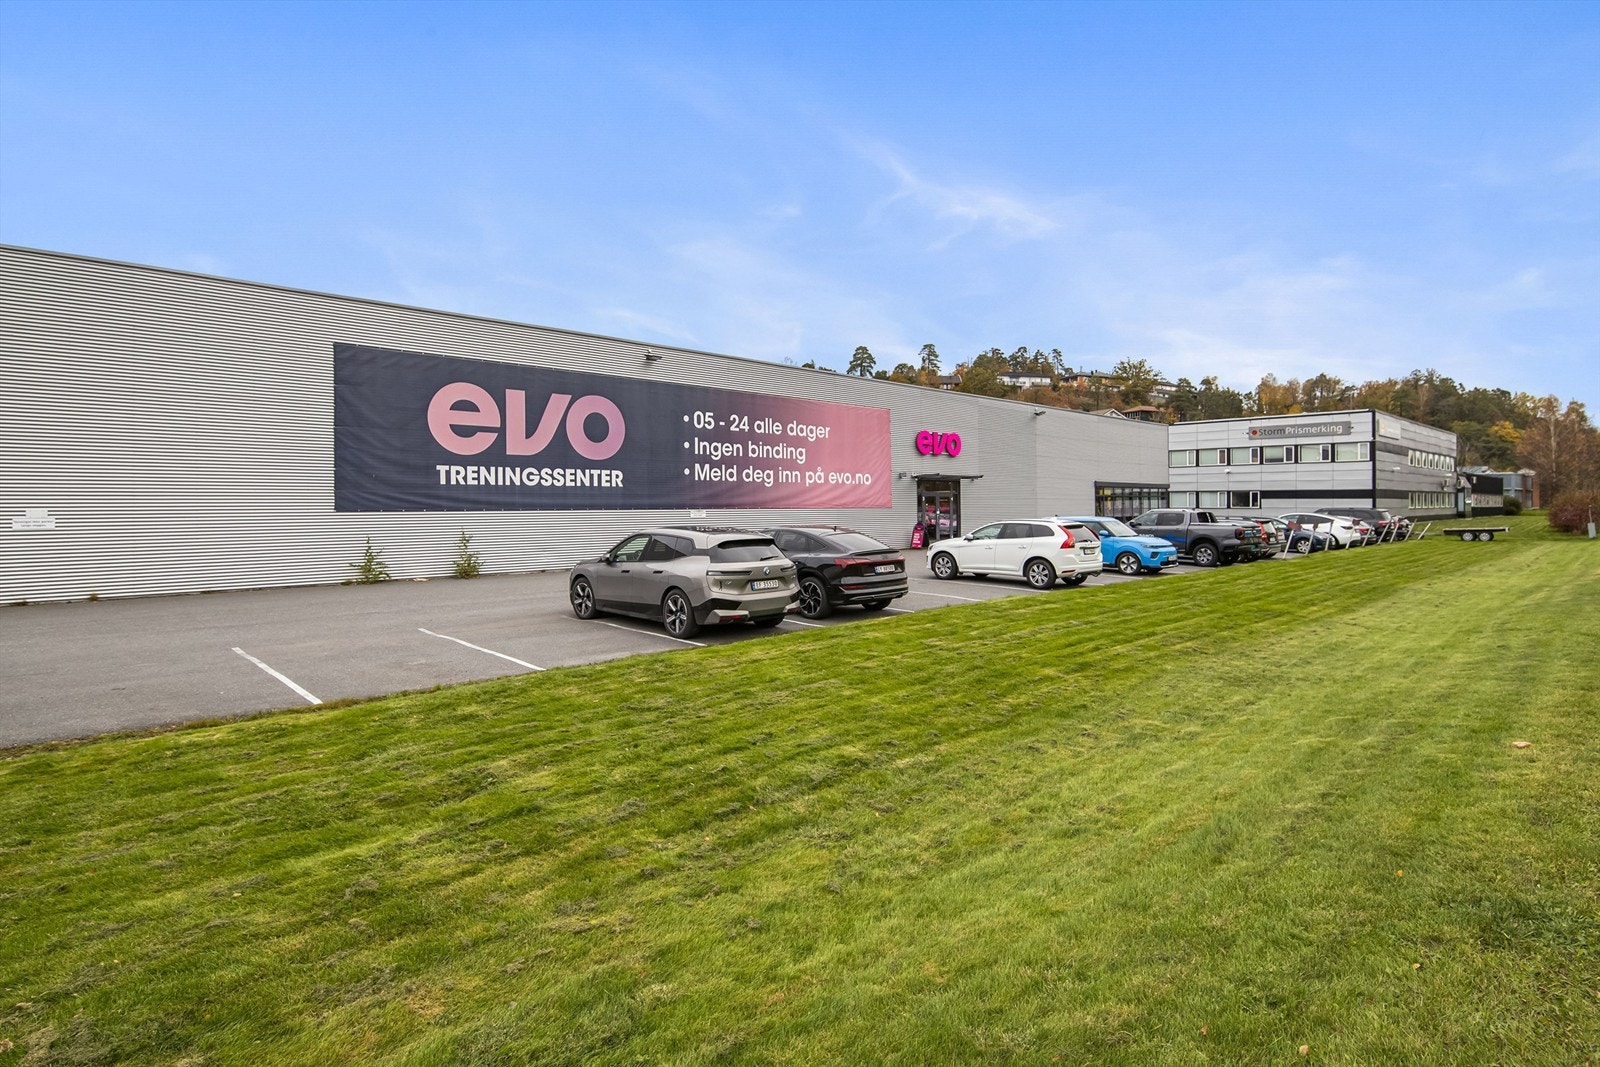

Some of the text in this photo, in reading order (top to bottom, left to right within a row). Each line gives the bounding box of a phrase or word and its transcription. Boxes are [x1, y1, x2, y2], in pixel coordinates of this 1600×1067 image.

[427, 382, 626, 461] evo
[693, 410, 715, 430] 05
[729, 414, 750, 432] 24
[754, 417, 783, 435] alle
[787, 420, 831, 442] dager
[694, 437, 806, 464] Ingen binding
[915, 429, 962, 457] evo
[436, 464, 624, 488] TRENINGSSENTER
[694, 463, 872, 487] Meld deg inn på evo.no
